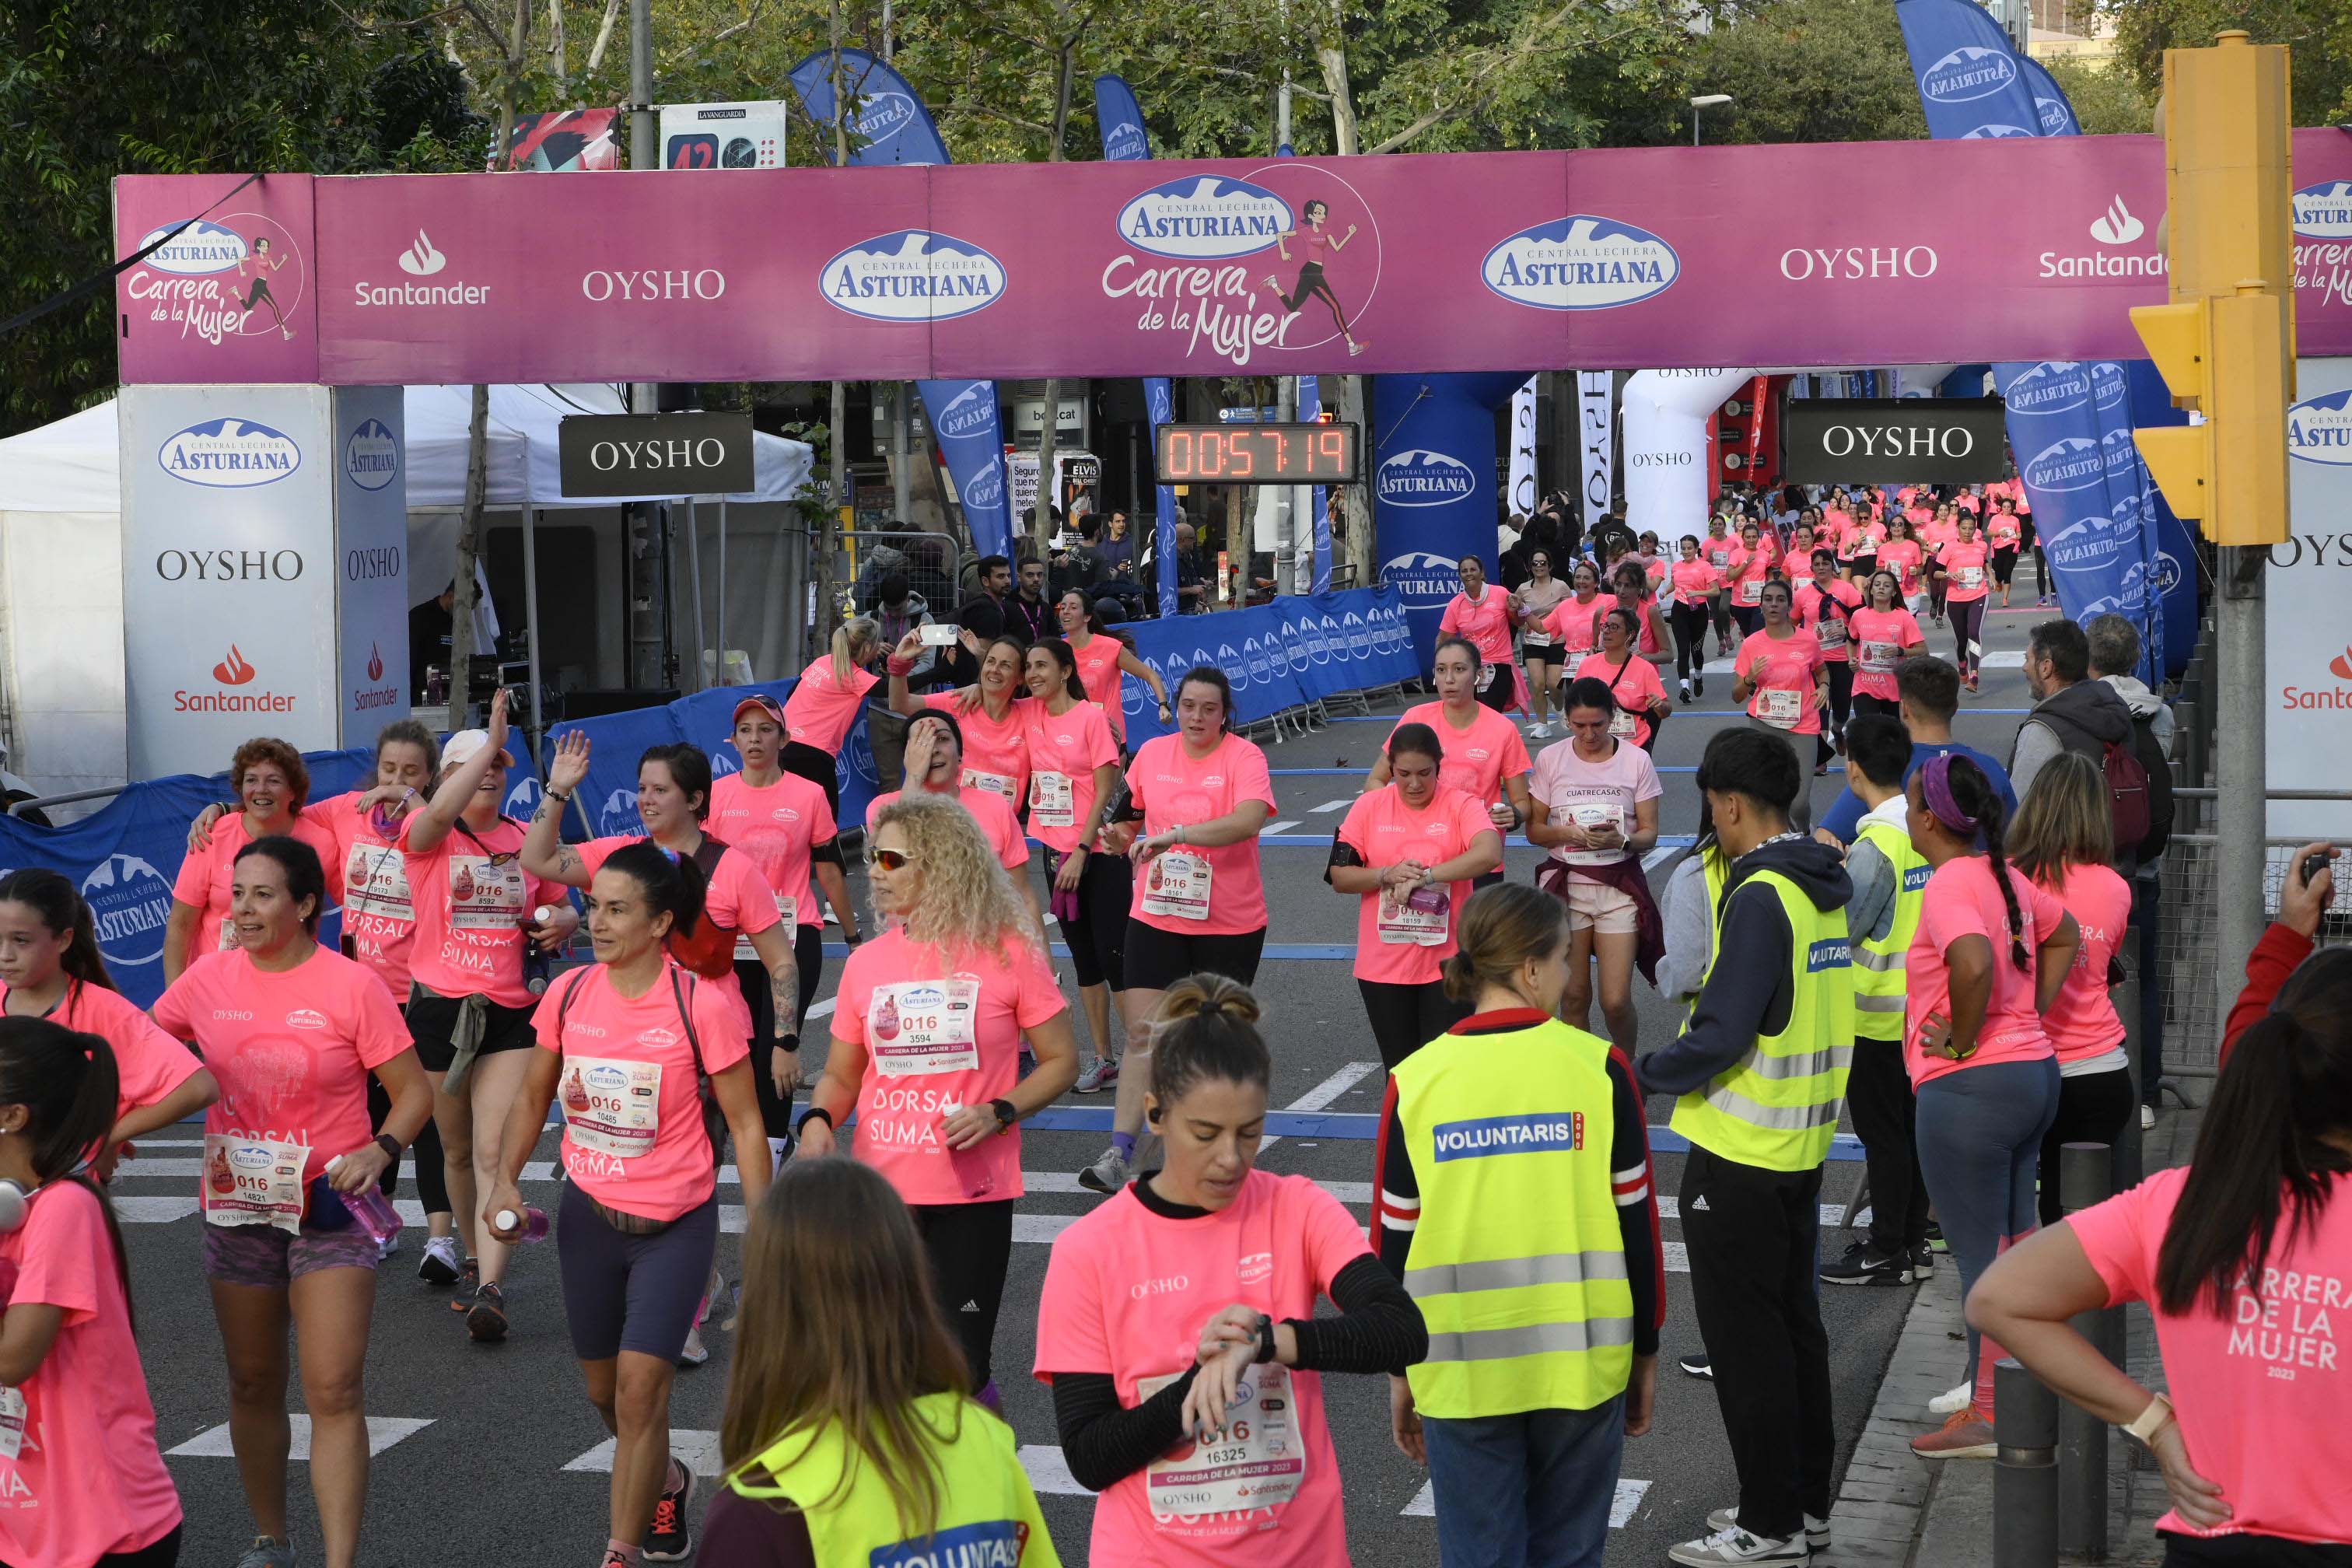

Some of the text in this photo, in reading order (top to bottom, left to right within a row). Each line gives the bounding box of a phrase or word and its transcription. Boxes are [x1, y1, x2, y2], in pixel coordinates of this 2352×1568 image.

[1219, 203, 1275, 212] LECHERA
[1130, 207, 1279, 239] ASTURIANA
[1527, 247, 1658, 259] CENTRAL LECHERA
[1780, 245, 1938, 281] OYSHO
[862, 261, 986, 271] CENTRAL LECHERA
[1496, 252, 1665, 287] ASTURIANA
[2039, 251, 2168, 277] Santand
[128, 271, 219, 299] Carrera
[583, 269, 726, 302] OYSHO
[833, 264, 993, 299] ASTURIANA
[1101, 254, 1247, 299] Carrera
[355, 281, 491, 306] Santander
[150, 296, 254, 346] de la Mujer
[1138, 292, 1302, 366] de la Mujer
[1822, 425, 1973, 457] OYSHO
[170, 443, 291, 471] ASTURIANA
[349, 445, 395, 473] ASTURIANA
[590, 438, 725, 471] OYSHO
[1168, 432, 1343, 475] 00:57:19
[1633, 451, 1692, 467] OYSHO
[1073, 465, 1097, 475] ELVIS
[1014, 479, 1027, 488] que
[1380, 472, 1468, 494] ASTURIANA
[2268, 533, 2352, 568] OYS
[156, 549, 303, 581] OYSHO
[348, 546, 400, 581] OYSHO
[173, 690, 296, 712] Santander
[355, 688, 397, 712] Santander
[1566, 789, 1621, 797] CUATRECASAS
[370, 886, 389, 894] 19173
[476, 885, 503, 896] 016
[1164, 877, 1186, 888] 016
[441, 941, 494, 971] SUMA
[902, 996, 941, 1005] ASTURIANA
[212, 1010, 253, 1022] OYSHO
[902, 1016, 938, 1031] 016
[566, 1020, 606, 1038] OYSHO
[909, 1034, 931, 1043] 3594
[885, 1060, 913, 1069] OYSHO
[936, 1057, 970, 1066] Santander
[588, 1074, 625, 1086] ASTURIANA
[591, 1096, 622, 1112] 016
[597, 1111, 617, 1125] 10485
[611, 1127, 631, 1136] MUJER
[870, 1118, 938, 1146] SUMA
[1436, 1122, 1570, 1153] VOLUNTARIS
[233, 1152, 270, 1165] ASTURIANA
[236, 1174, 268, 1191] 016
[243, 1192, 267, 1202] 14821
[1131, 1275, 1188, 1300] OYSHO
[2236, 1295, 2333, 1339] DE LA
[2227, 1325, 2338, 1371] MUJER
[2266, 1365, 2296, 1381] 2023
[1206, 1447, 1246, 1464] 16325
[1166, 1473, 1209, 1483] CARRERA
[1238, 1465, 1269, 1475] MUJER
[1272, 1462, 1291, 1472] 2023
[1163, 1492, 1212, 1506] OYSHO
[1250, 1482, 1293, 1495] Santander
